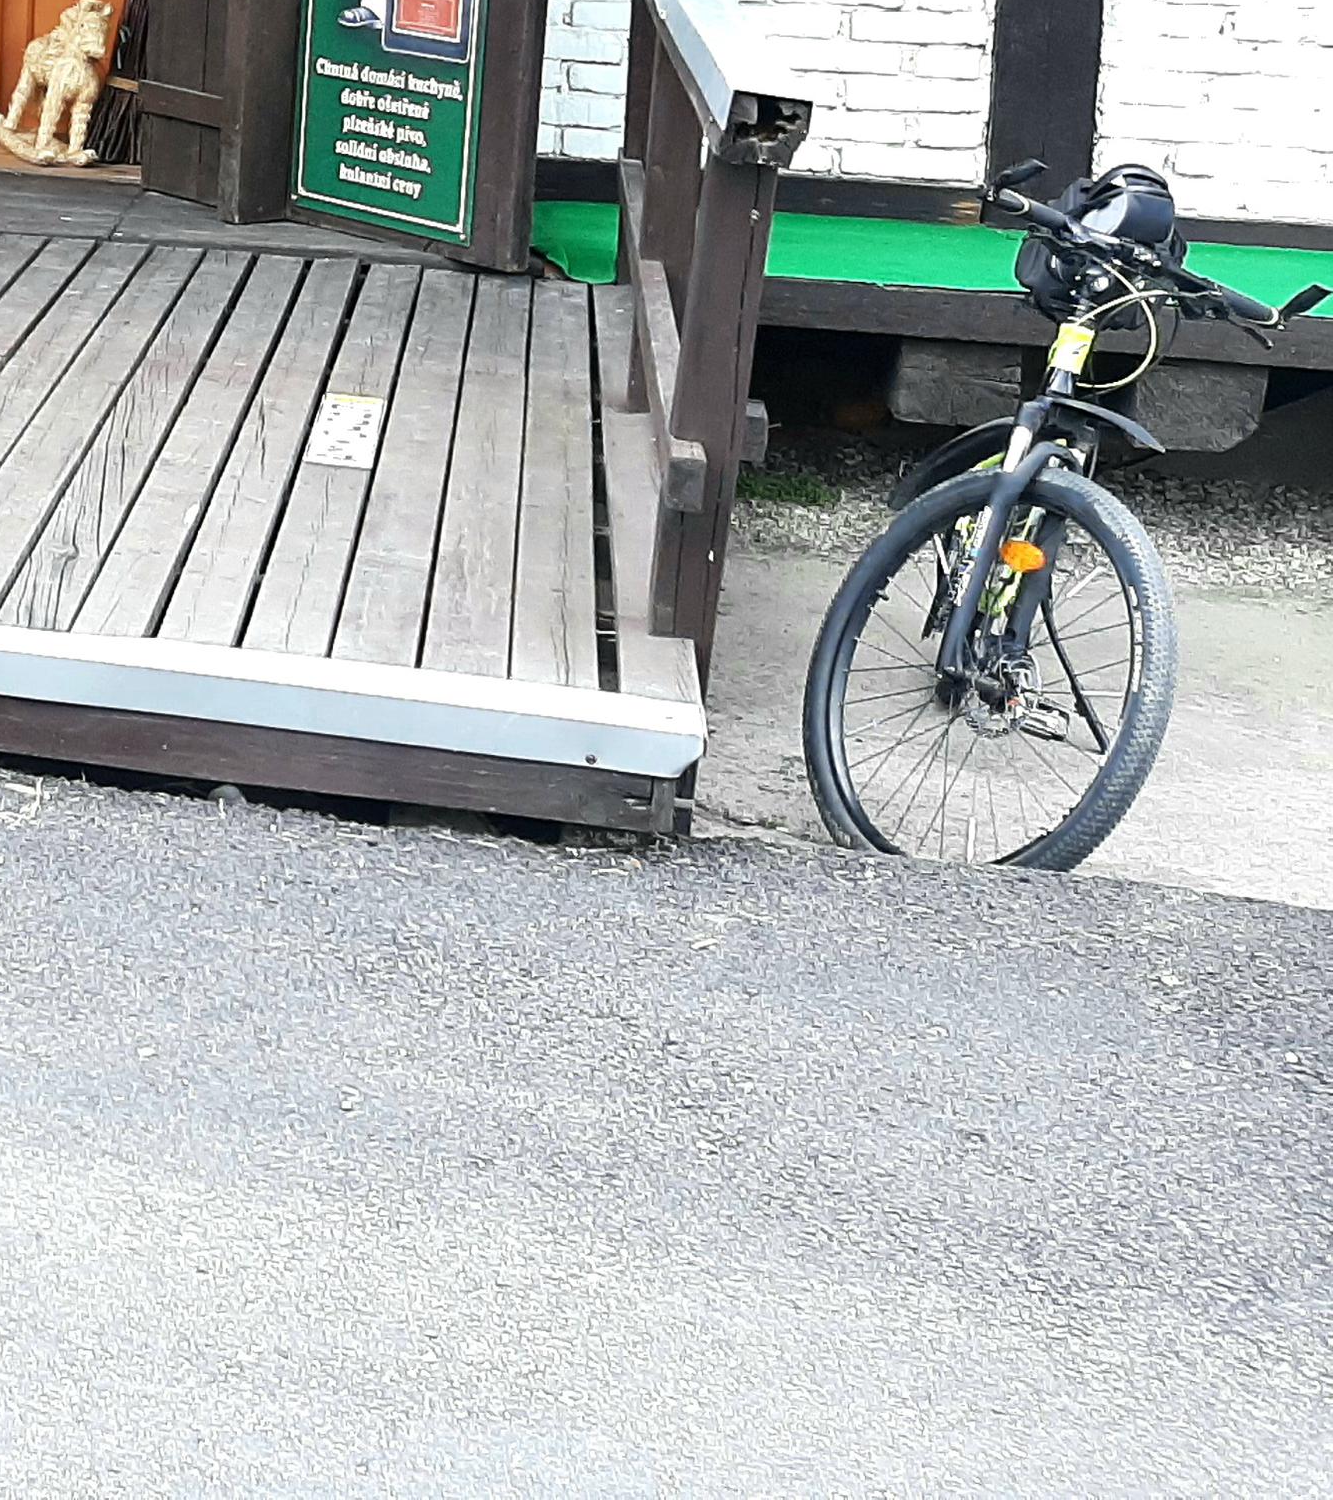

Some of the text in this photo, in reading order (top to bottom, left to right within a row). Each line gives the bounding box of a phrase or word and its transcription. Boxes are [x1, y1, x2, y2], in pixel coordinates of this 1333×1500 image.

[360, 65, 406, 90] domácí
[340, 88, 376, 110] dobře
[342, 114, 427, 148] plzeňské pivo,
[335, 139, 378, 162] solidní
[339, 162, 422, 200] kulantní ceny
